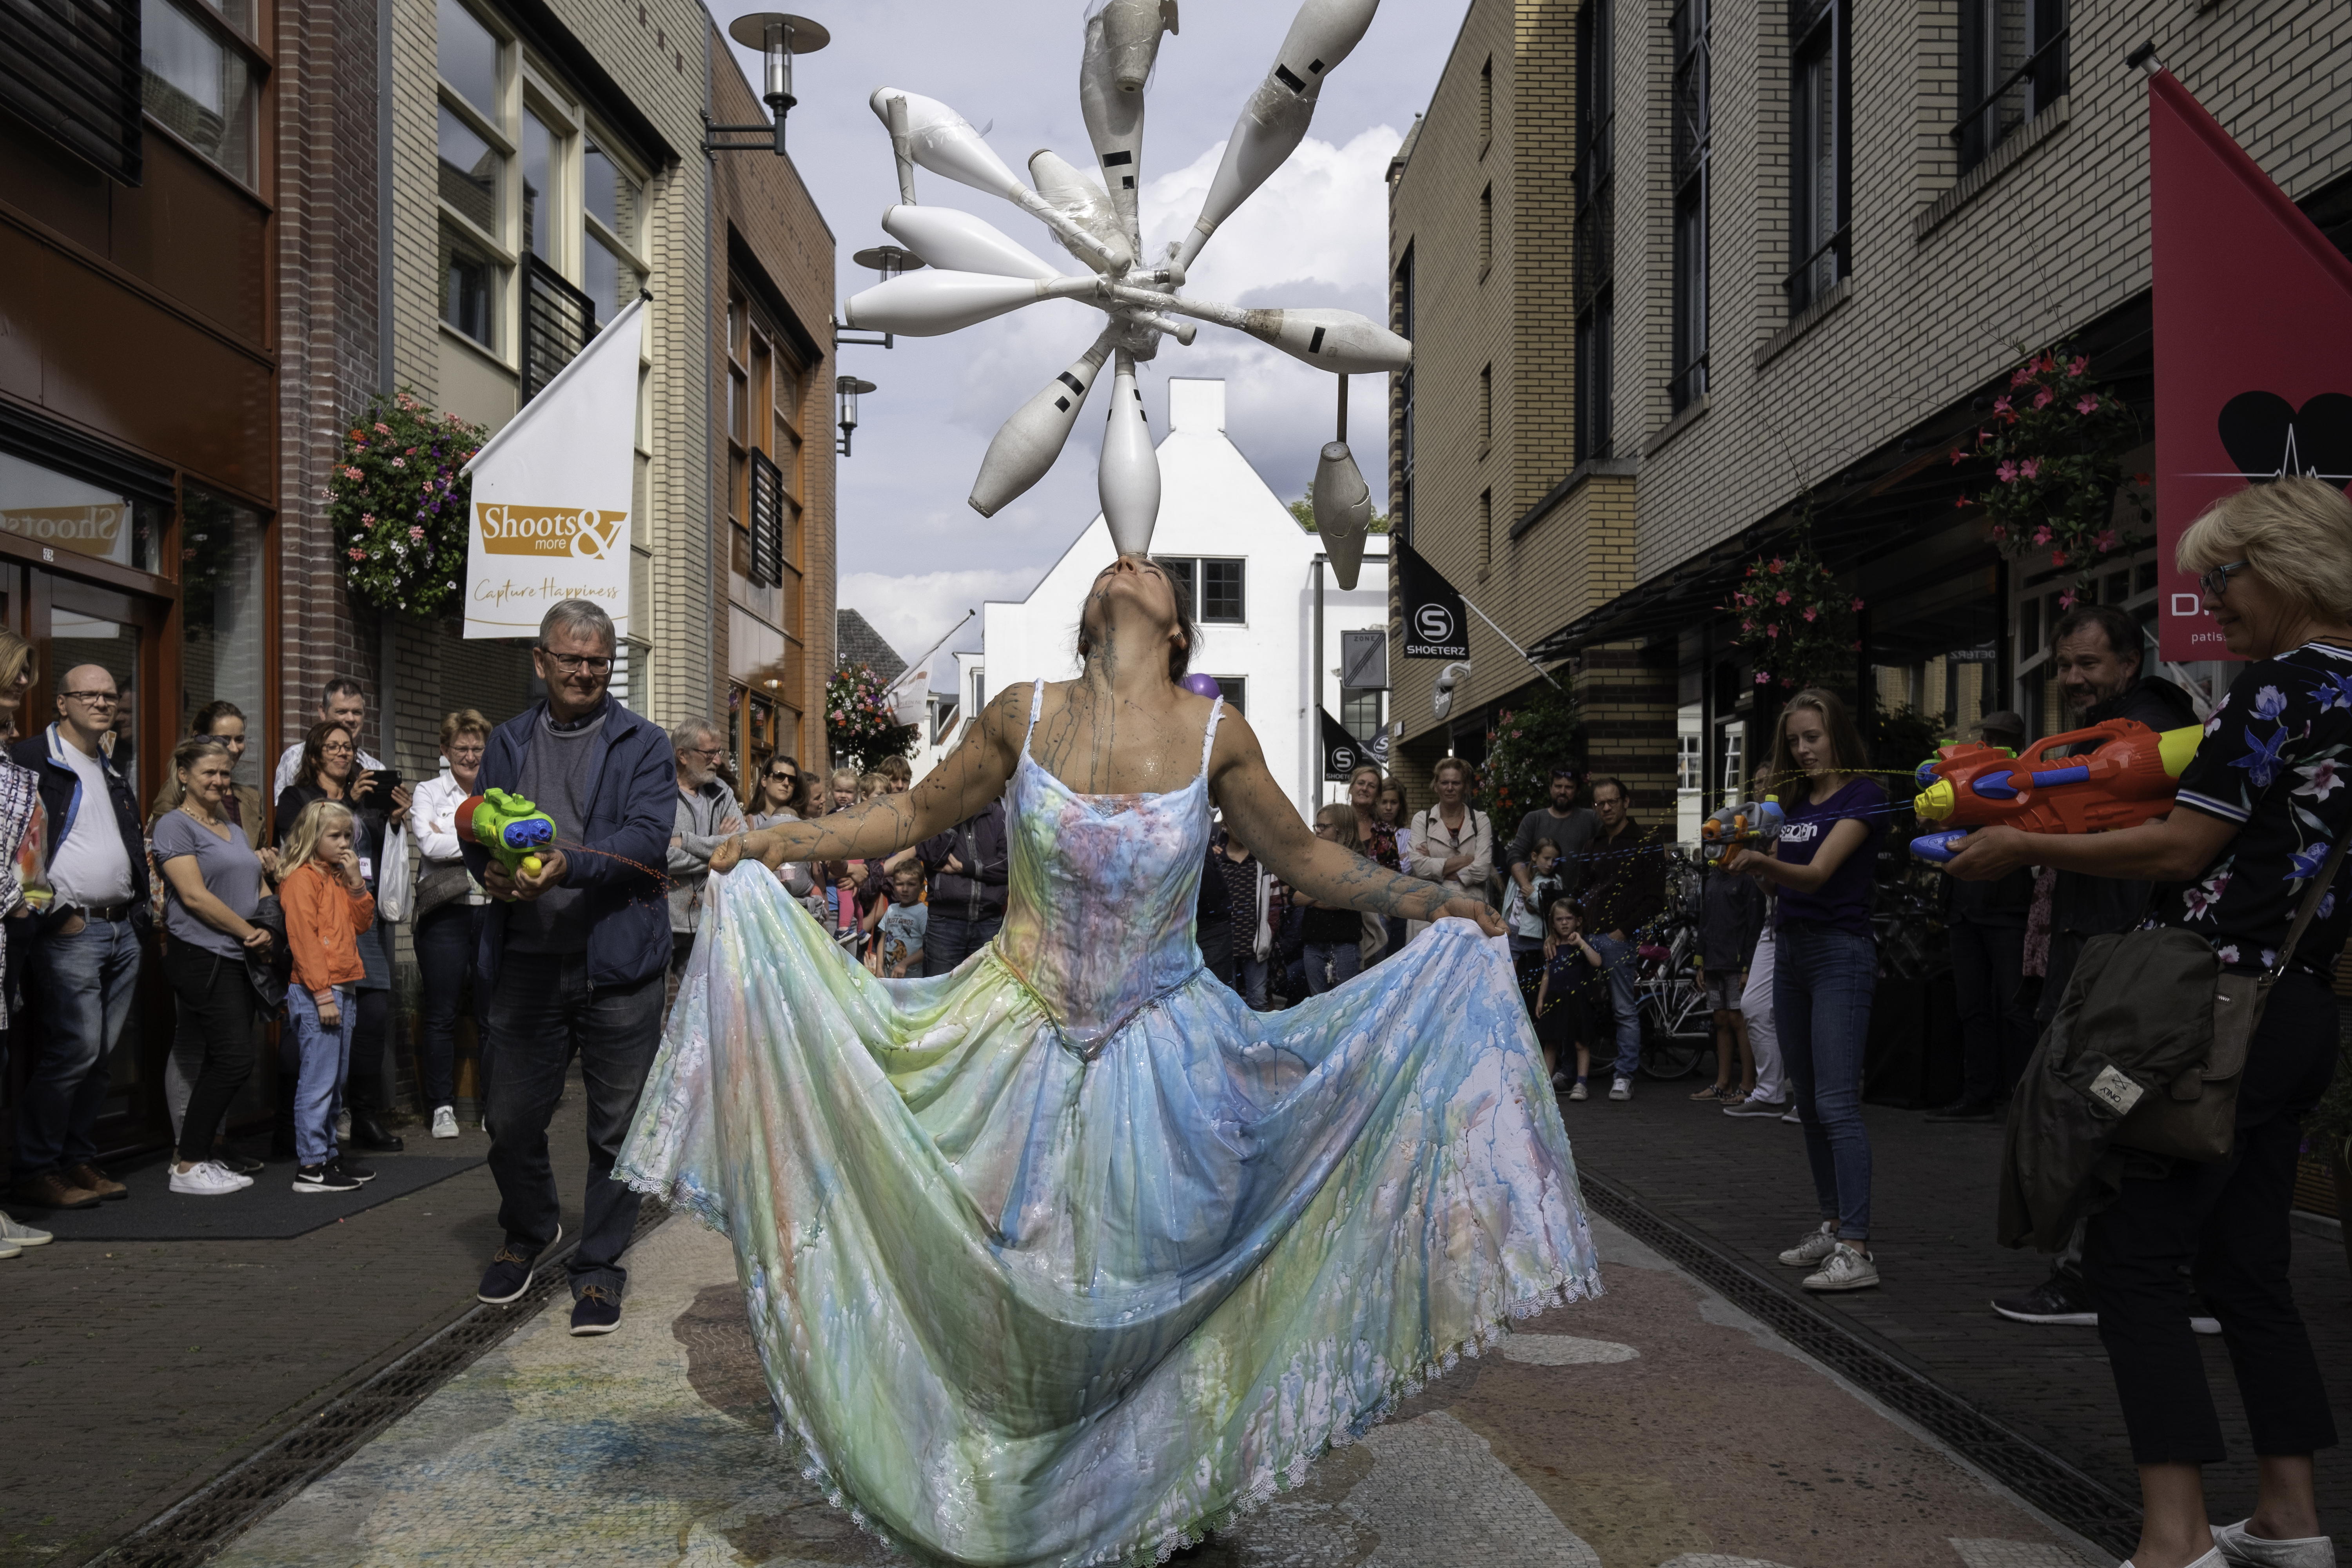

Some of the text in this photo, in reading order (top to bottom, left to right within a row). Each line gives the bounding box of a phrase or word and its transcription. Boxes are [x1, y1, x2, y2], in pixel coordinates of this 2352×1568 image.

[535, 538, 566, 550] more
[44, 549, 52, 560] 23
[474, 577, 621, 608] Capture Happiness
[1407, 645, 1465, 655] SHOETERZ
[2100, 1087, 2121, 1102] ONLY
